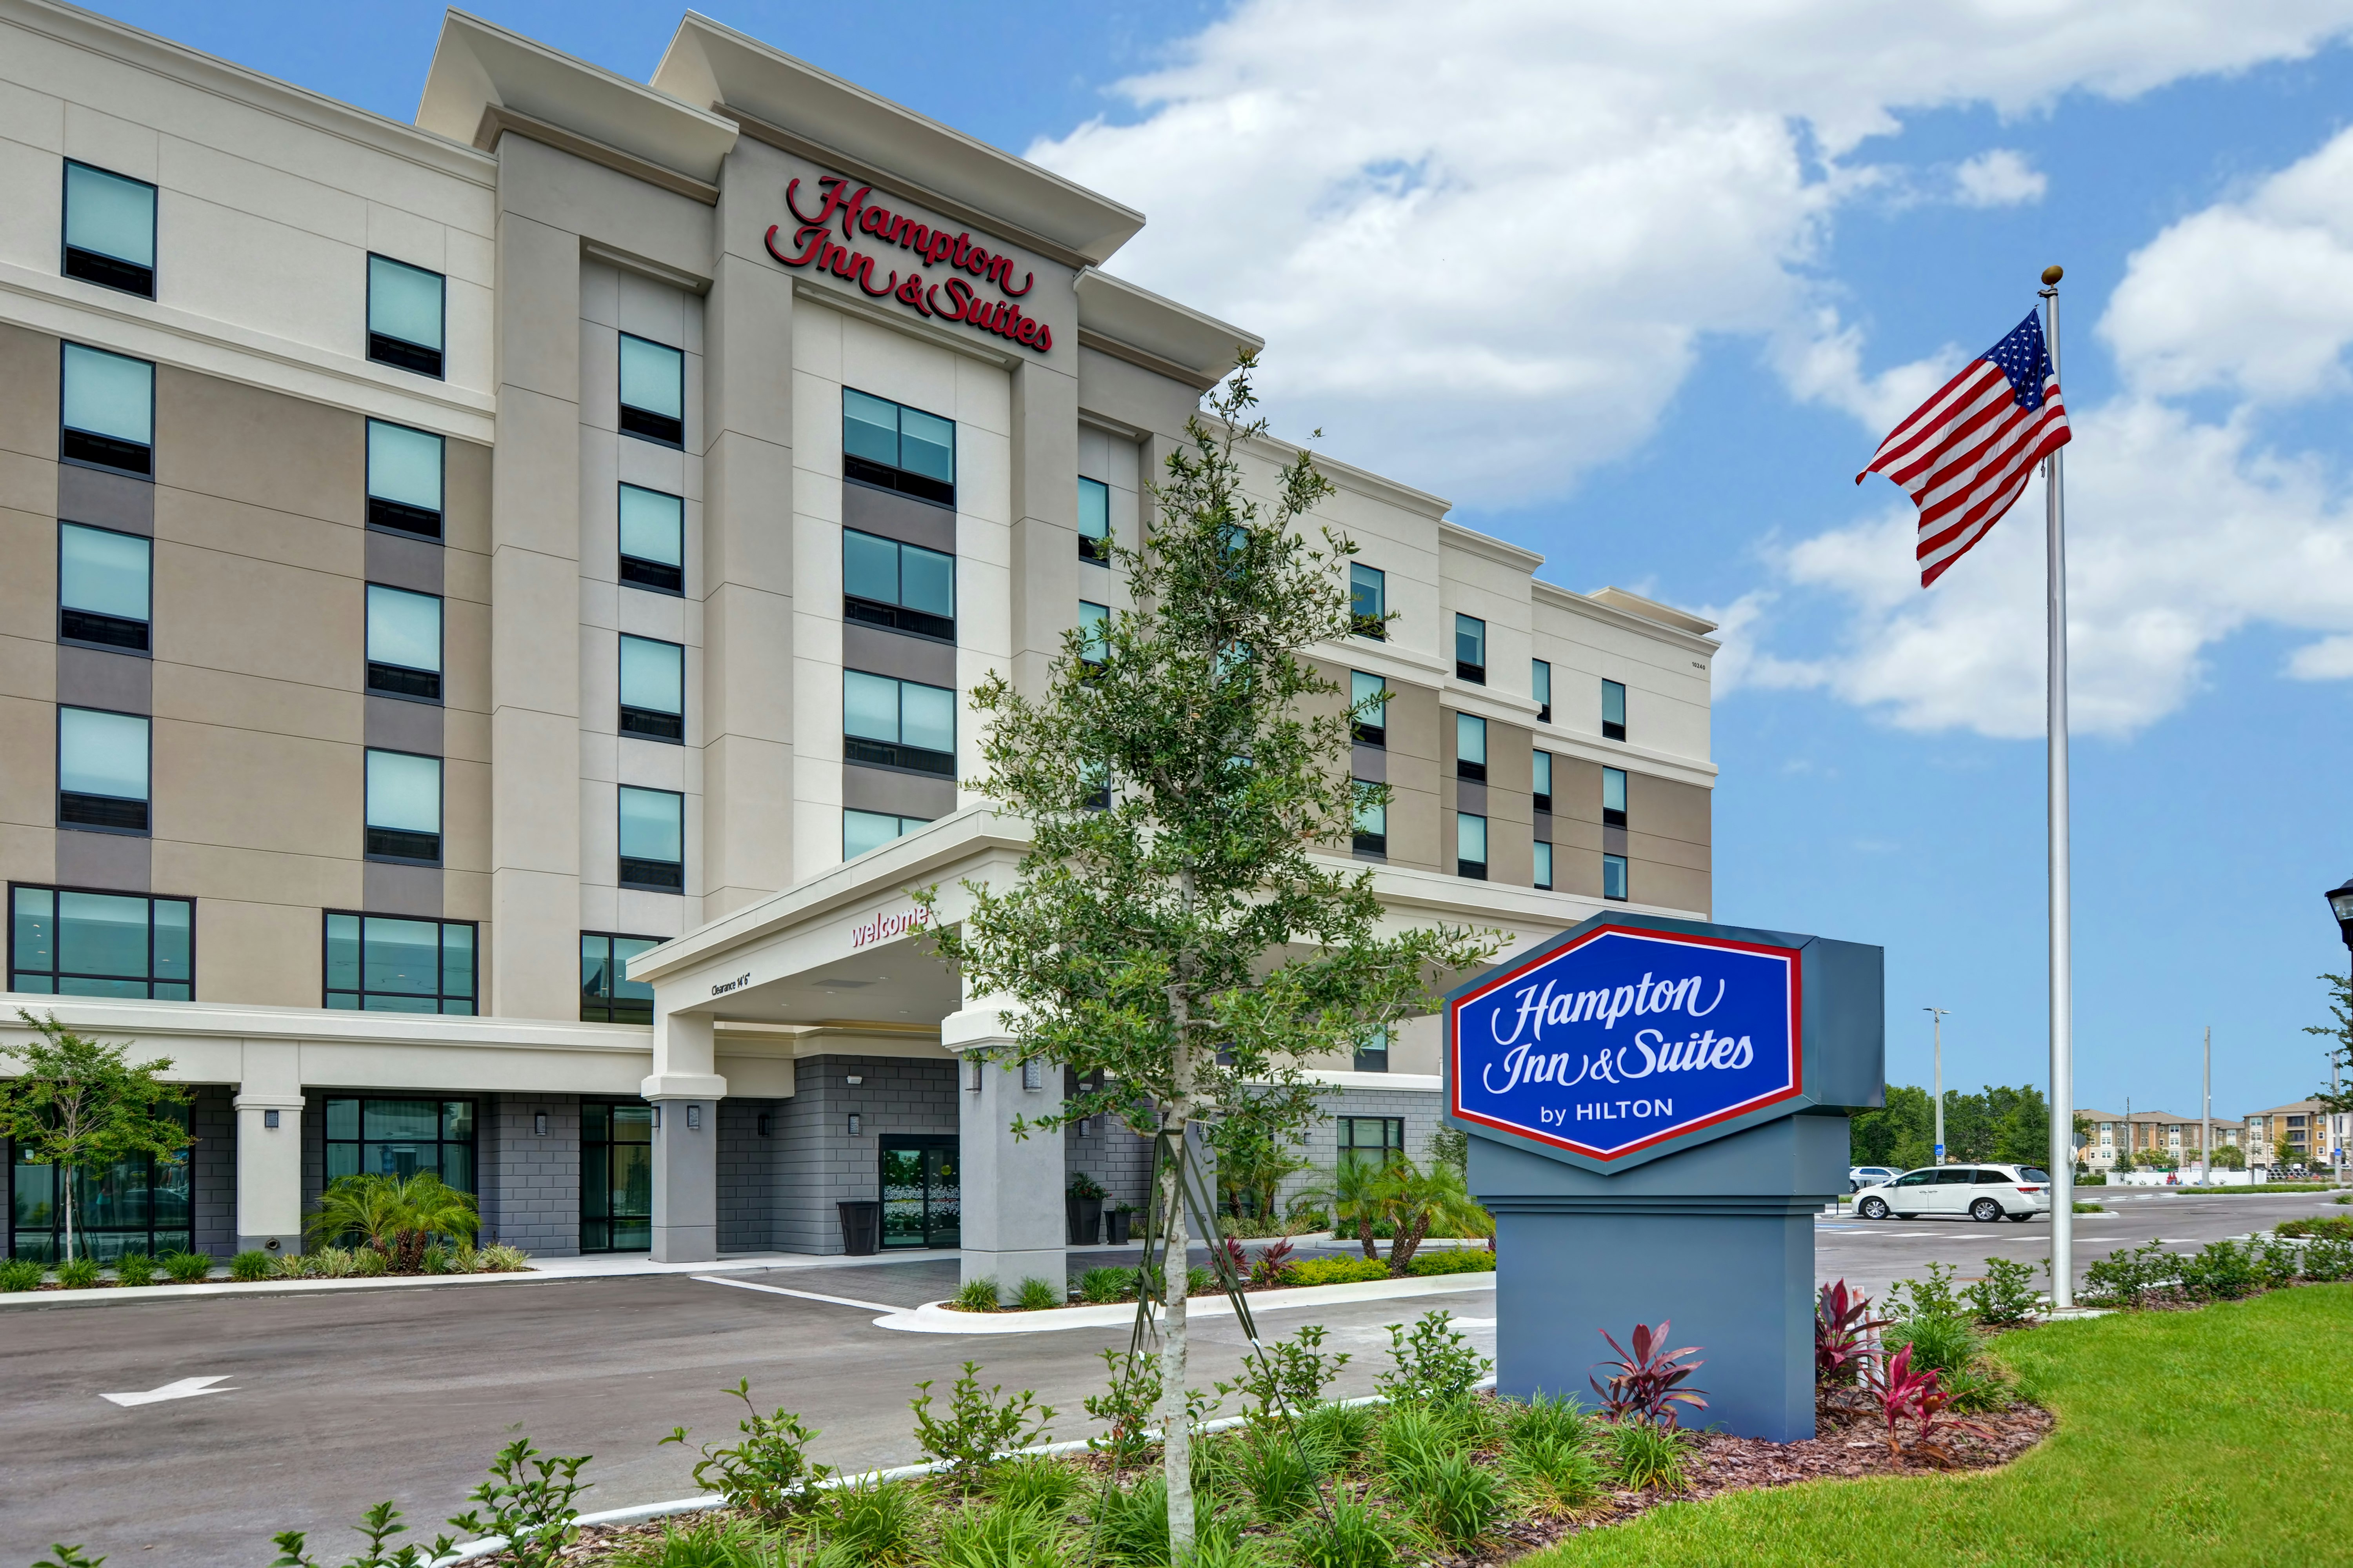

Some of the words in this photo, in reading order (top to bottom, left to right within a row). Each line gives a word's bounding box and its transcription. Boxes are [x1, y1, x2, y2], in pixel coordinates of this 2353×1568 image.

[786, 176, 1034, 298] Hampton
[764, 225, 896, 297] Inn
[895, 273, 933, 317] &
[926, 277, 1053, 353] Suites
[1692, 661, 1706, 670] 10240
[851, 905, 929, 947] welcome
[711, 981, 736, 996] Clearance
[1491, 971, 1726, 1045] Hampton
[1483, 1043, 1588, 1094] Inn
[1589, 1049, 1620, 1084] &
[1617, 1028, 1754, 1078] Suites
[1541, 1107, 1566, 1126] by
[1576, 1098, 1673, 1121] HILTON
